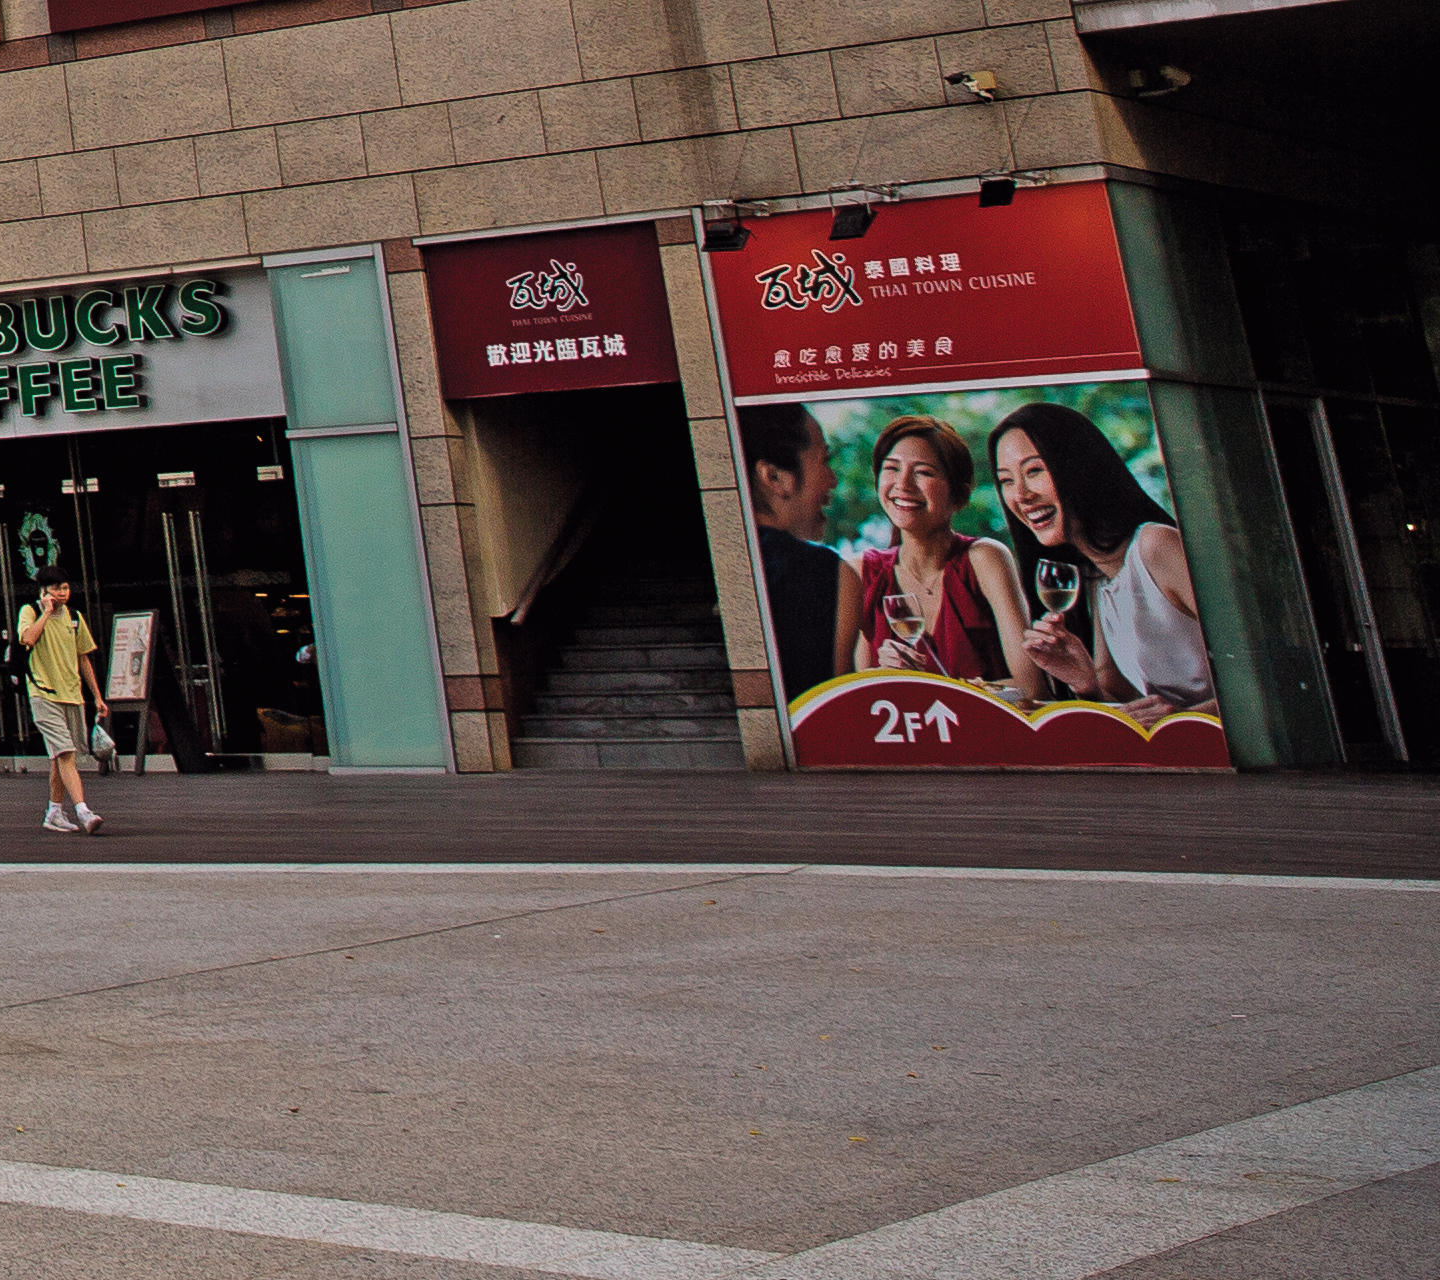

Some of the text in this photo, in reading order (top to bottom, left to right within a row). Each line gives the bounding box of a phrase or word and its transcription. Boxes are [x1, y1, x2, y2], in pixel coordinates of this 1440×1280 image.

[863, 252, 962, 280] 泰國料理
[868, 271, 1037, 299] THAI TOWN CUISINE
[511, 312, 594, 327] THAI TOWN CUISINE
[486, 333, 628, 367] 歡迎光臨瓦城
[773, 336, 954, 369] 愈吃愈愛的美食
[835, 364, 892, 381] Delicacies
[870, 700, 923, 743] 2F
